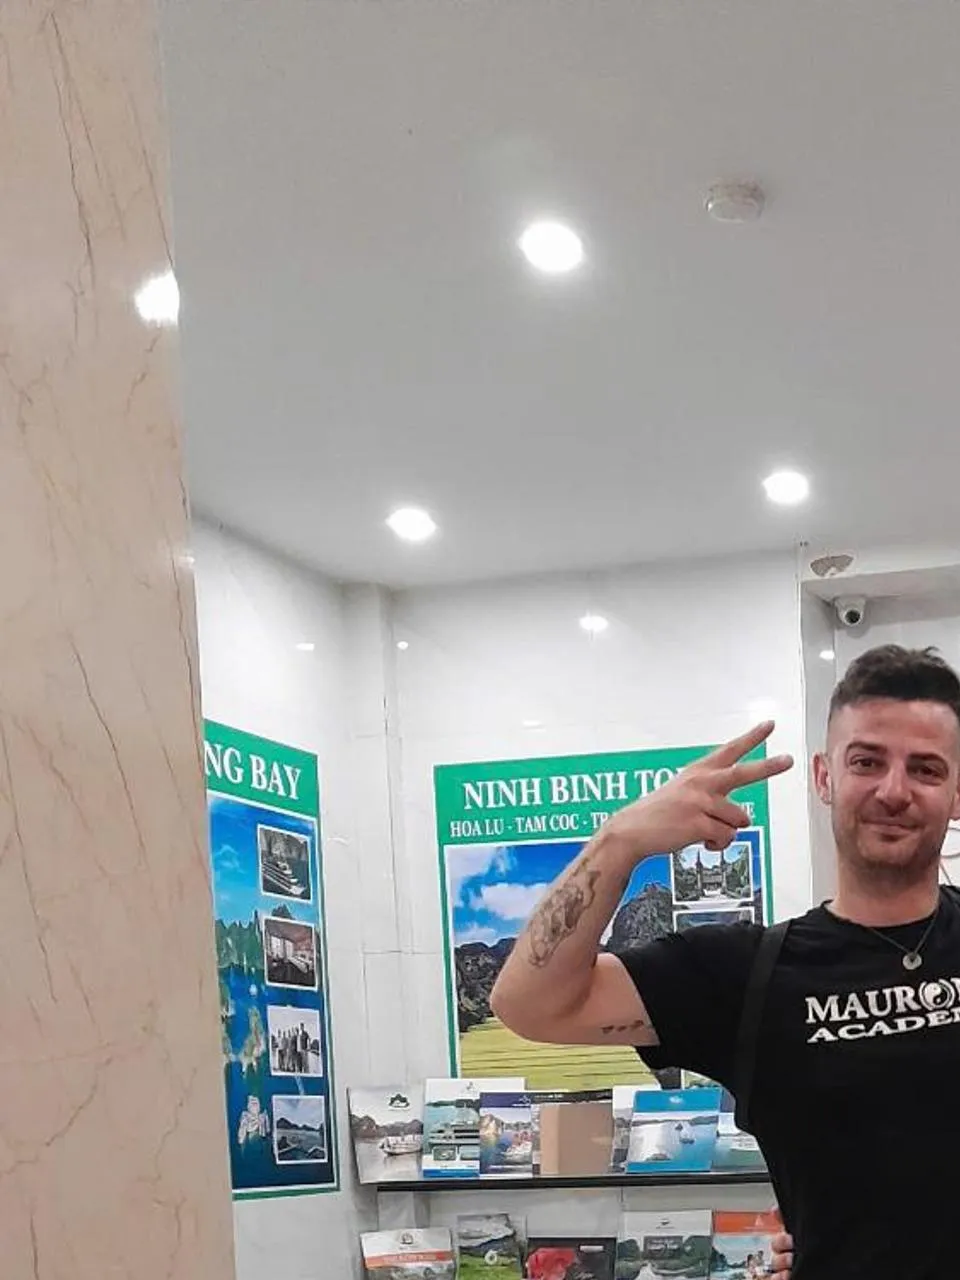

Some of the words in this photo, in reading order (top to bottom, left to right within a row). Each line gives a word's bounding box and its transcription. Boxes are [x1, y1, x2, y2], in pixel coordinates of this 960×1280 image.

[249, 753, 301, 800] BAY
[463, 777, 542, 810] NINH
[550, 771, 628, 805] BINH
[634, 767, 684, 798] TO
[450, 820, 481, 838] HOA
[485, 818, 504, 836] LU
[515, 815, 546, 834] TAM
[550, 813, 579, 832] COC
